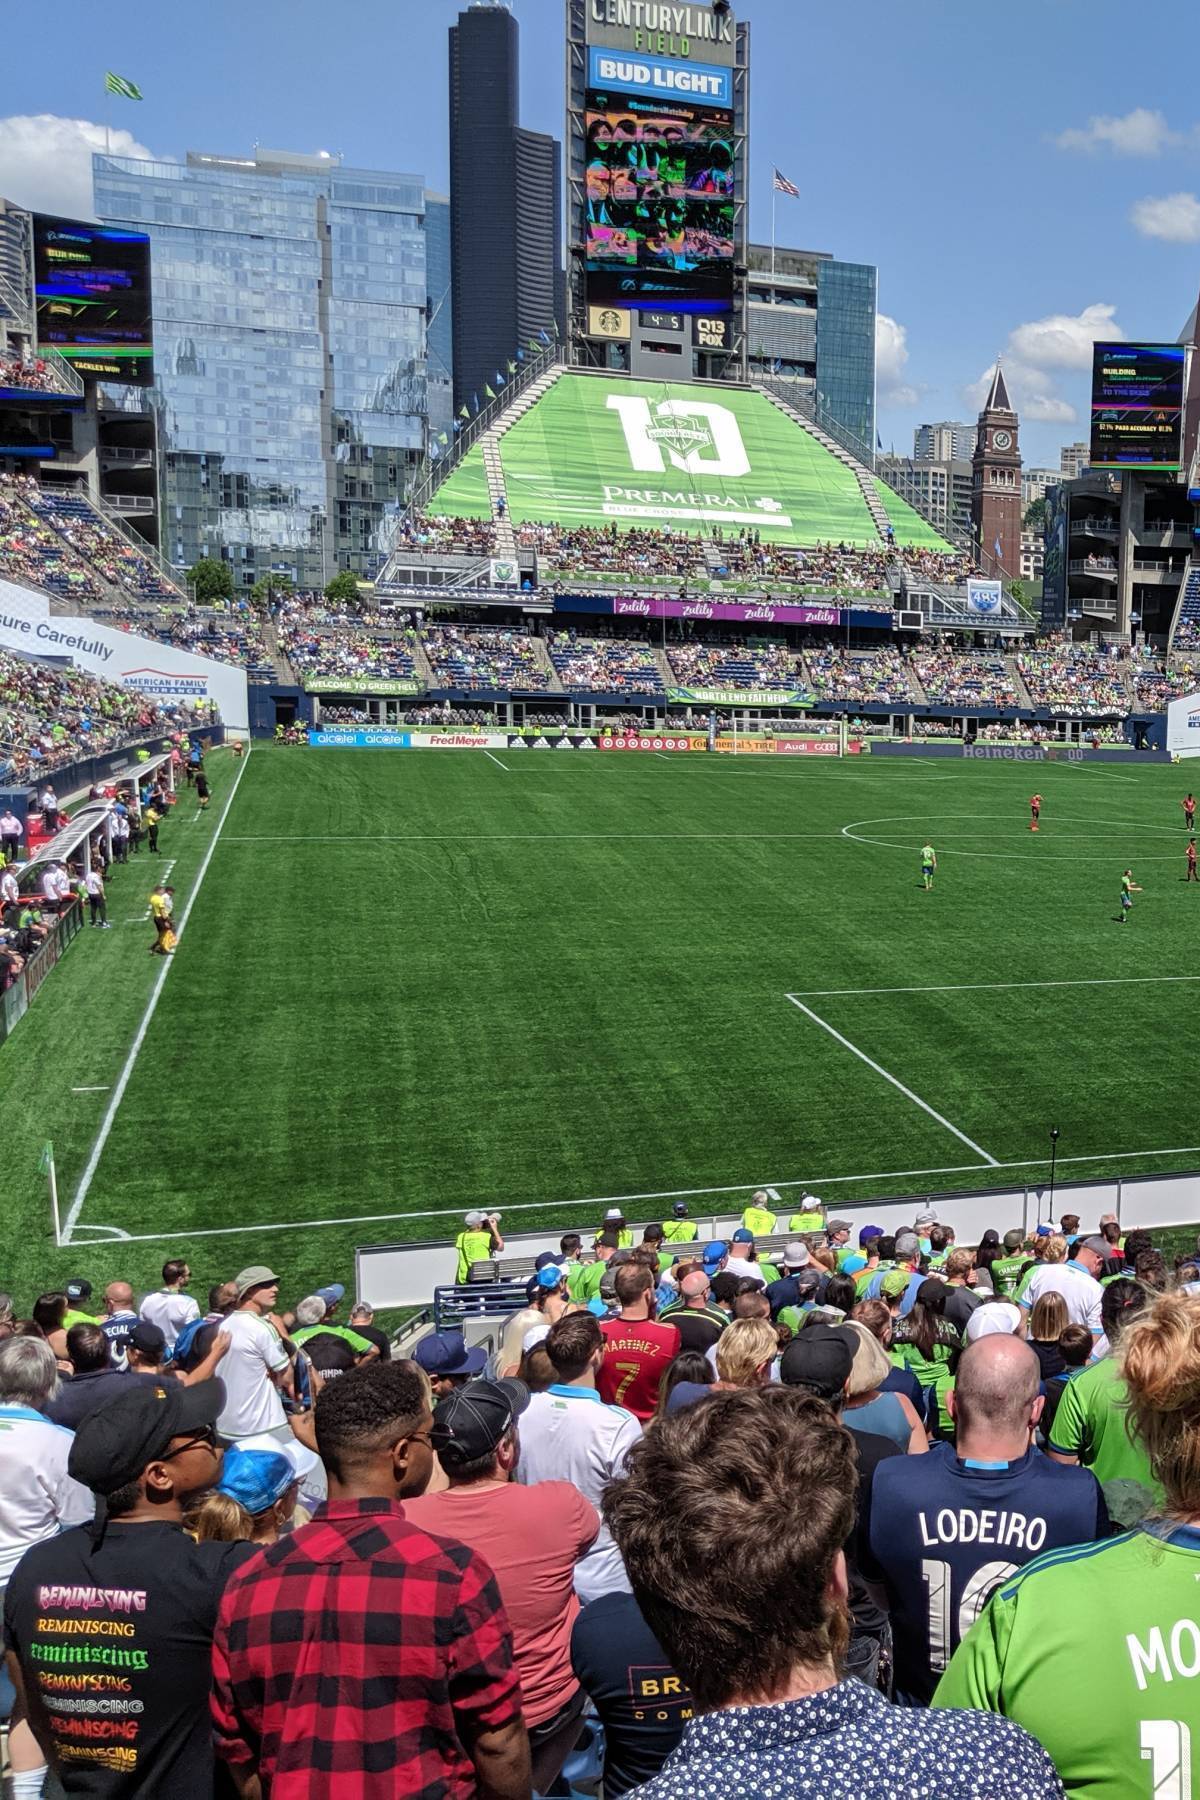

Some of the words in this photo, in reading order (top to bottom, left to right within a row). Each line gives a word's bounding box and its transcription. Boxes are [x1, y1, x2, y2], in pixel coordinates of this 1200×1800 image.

[592, 0, 732, 42] CENTURYLINK
[635, 30, 690, 57] FIELD
[600, 60, 650, 84] BUD
[653, 67, 723, 95] LIGHT
[697, 318, 725, 334] Q13
[698, 333, 723, 347] FOX
[606, 394, 751, 477] 10
[602, 485, 745, 509] PREMERA
[36, 622, 113, 661] Carefully
[124, 678, 172, 687] AMERICAN
[175, 679, 207, 688] FAMILY
[134, 687, 202, 695] NSURANCE
[308, 680, 352, 690] WELCOME
[355, 681, 367, 690] TO
[369, 681, 396, 691] GREEN
[695, 690, 727, 702] NORTH
[728, 692, 746, 703] END
[317, 734, 357, 744] alcatel
[366, 735, 404, 745] alcatel
[755, 742, 775, 751] TIRE
[784, 742, 808, 751] Audi
[963, 743, 1044, 760] Heineken
[615, 1362, 641, 1404] 7
[919, 1509, 1047, 1551] LODEIRO
[37, 1618, 136, 1637] REMINISCING
[31, 1641, 149, 1670] reminiscing
[641, 1676, 691, 1697] BR
